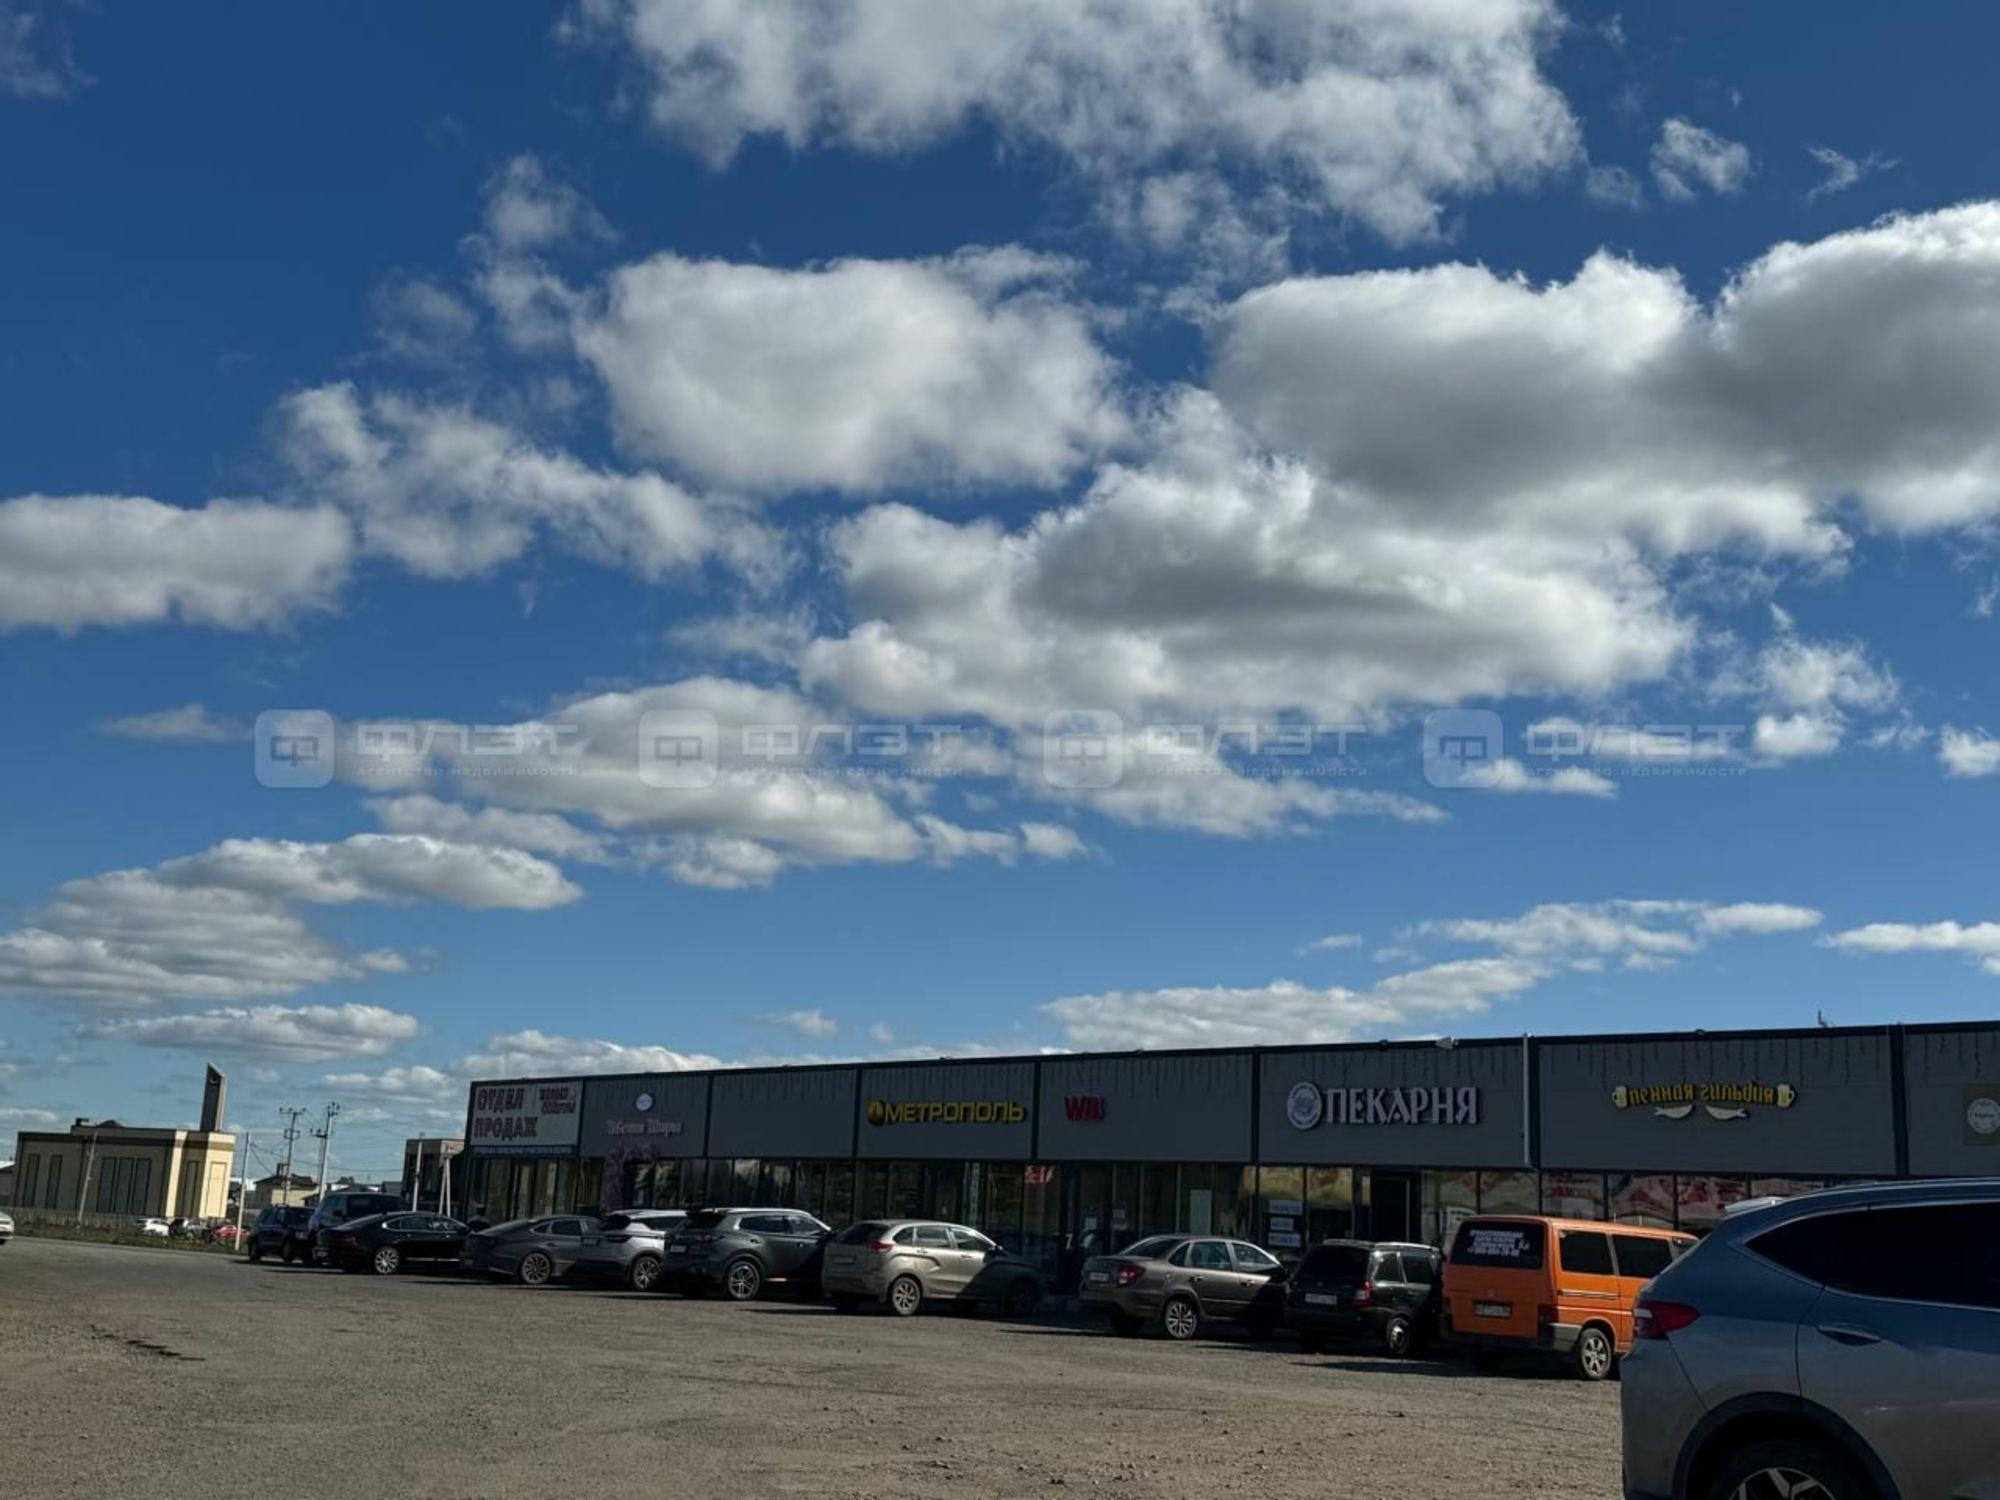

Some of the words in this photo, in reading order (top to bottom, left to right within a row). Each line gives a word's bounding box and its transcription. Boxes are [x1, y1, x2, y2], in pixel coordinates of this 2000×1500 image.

[478, 1087, 524, 1113] ОТДЕЛ
[884, 1100, 1025, 1123] МЕТРОПОЛЬ
[1066, 1096, 1103, 1120] WB
[1324, 1087, 1478, 1125] ПЕКАРНЯ
[474, 1116, 538, 1141] ПРОДАЖ
